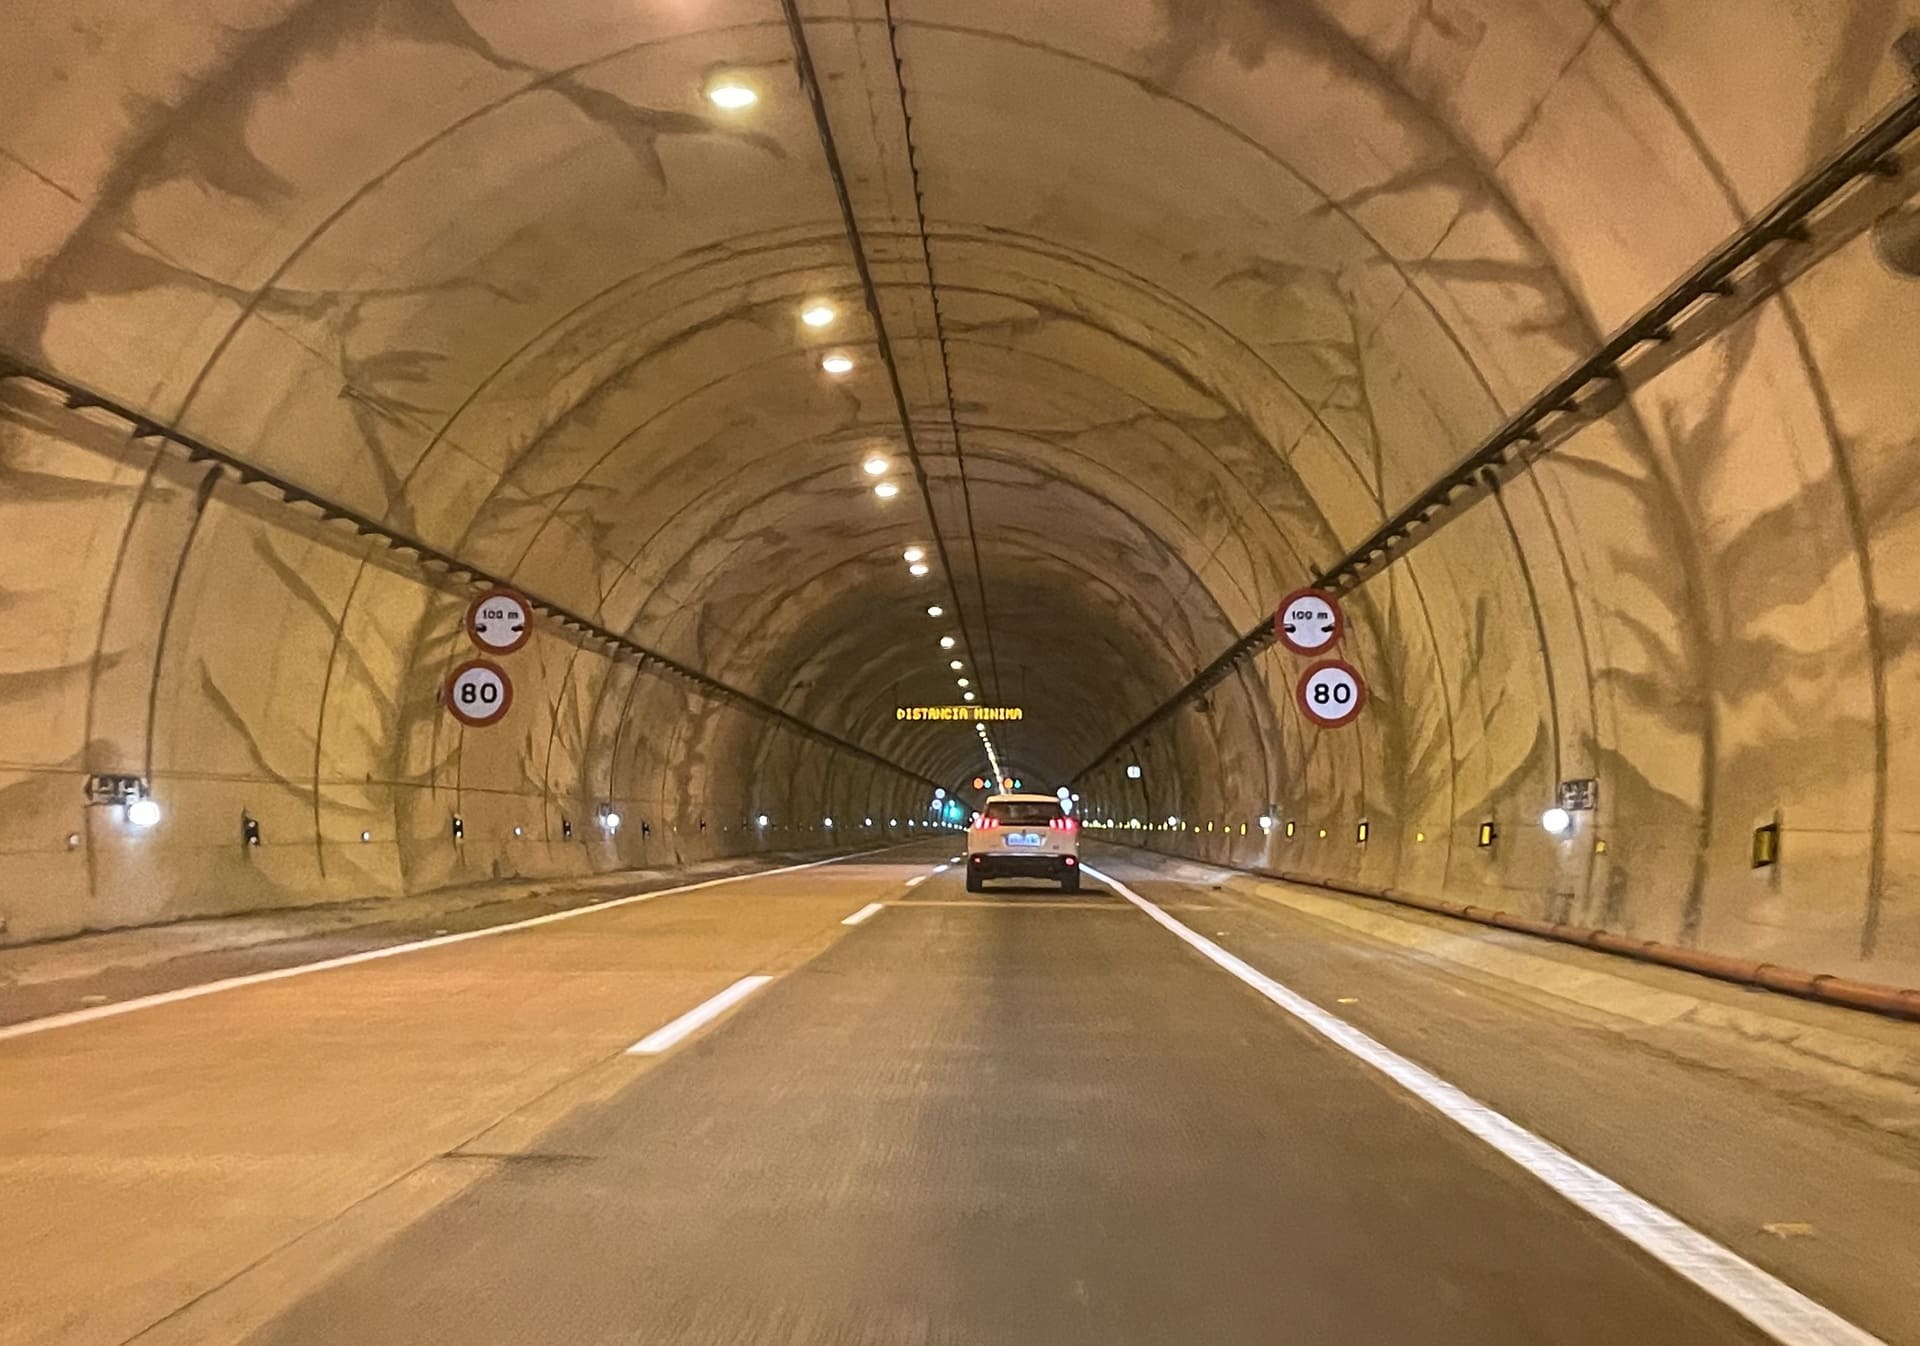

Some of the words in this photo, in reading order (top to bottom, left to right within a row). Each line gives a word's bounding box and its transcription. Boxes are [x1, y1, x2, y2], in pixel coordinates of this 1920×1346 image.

[483, 610, 503, 619] 100
[507, 611, 518, 619] m
[1292, 611, 1312, 620] 100
[1317, 611, 1328, 619] m
[461, 683, 497, 704] 80
[1314, 683, 1350, 704] 80
[896, 707, 969, 720] DISTANCIA
[973, 707, 1023, 720] MINIMA
